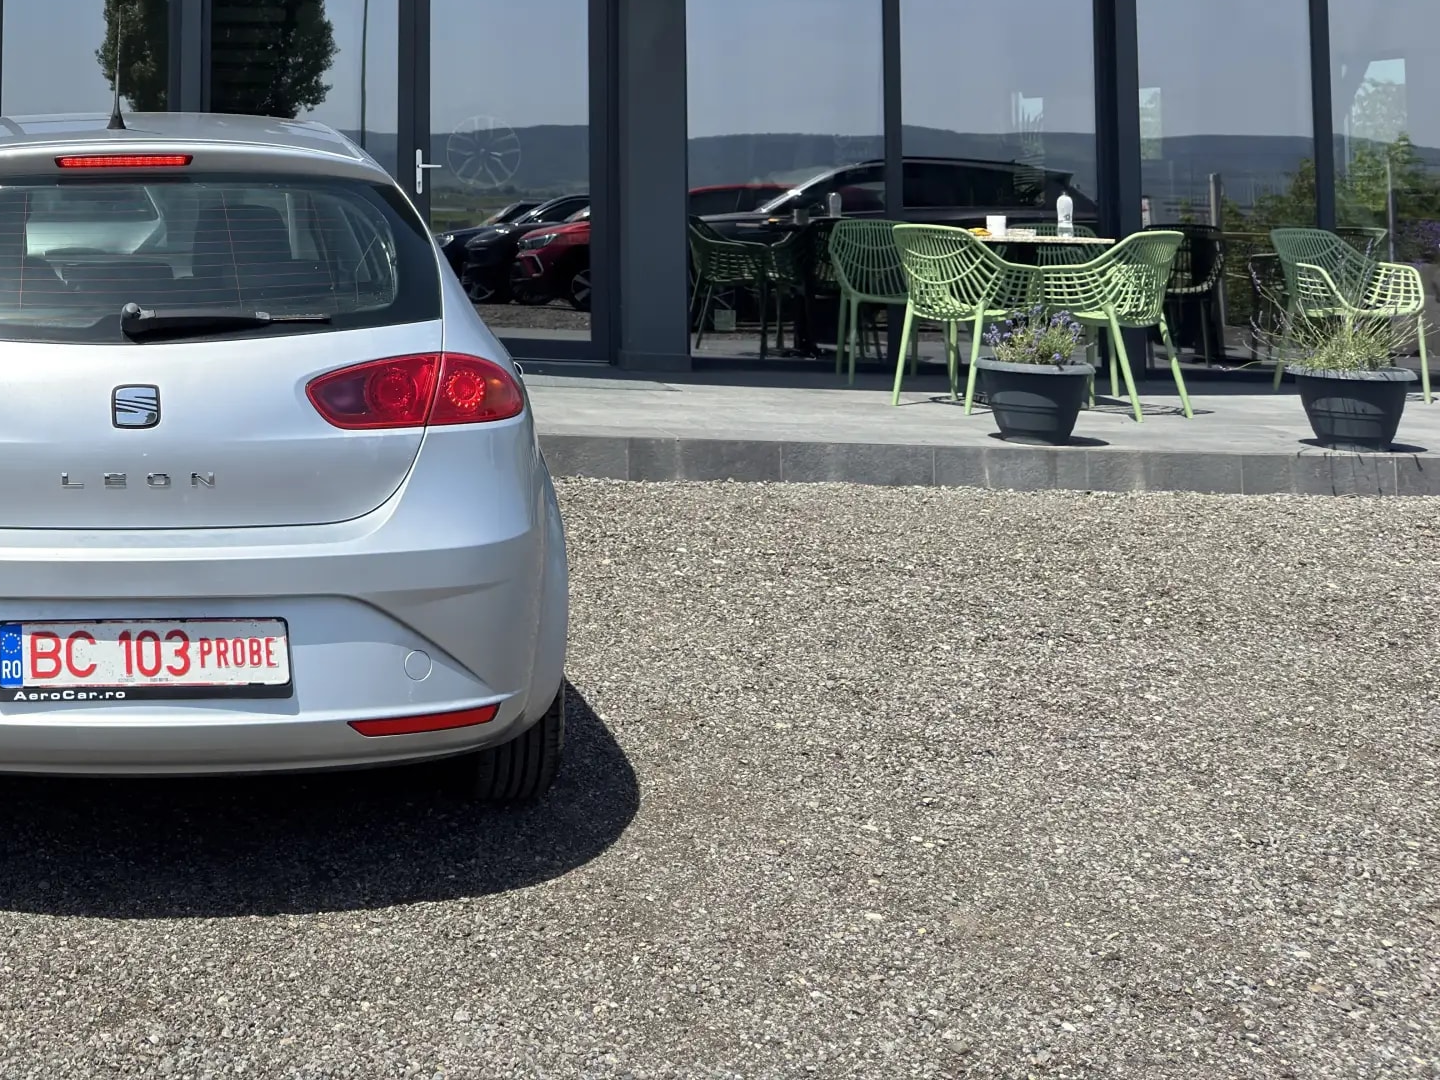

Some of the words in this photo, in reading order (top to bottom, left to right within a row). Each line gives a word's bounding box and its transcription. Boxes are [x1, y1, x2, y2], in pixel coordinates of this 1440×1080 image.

[61, 472, 215, 489] LEON
[29, 630, 98, 679] BC
[118, 628, 191, 678] 103
[199, 636, 280, 669] PROBE
[1, 659, 22, 680] RO
[13, 689, 127, 701] AeroCar.ro
